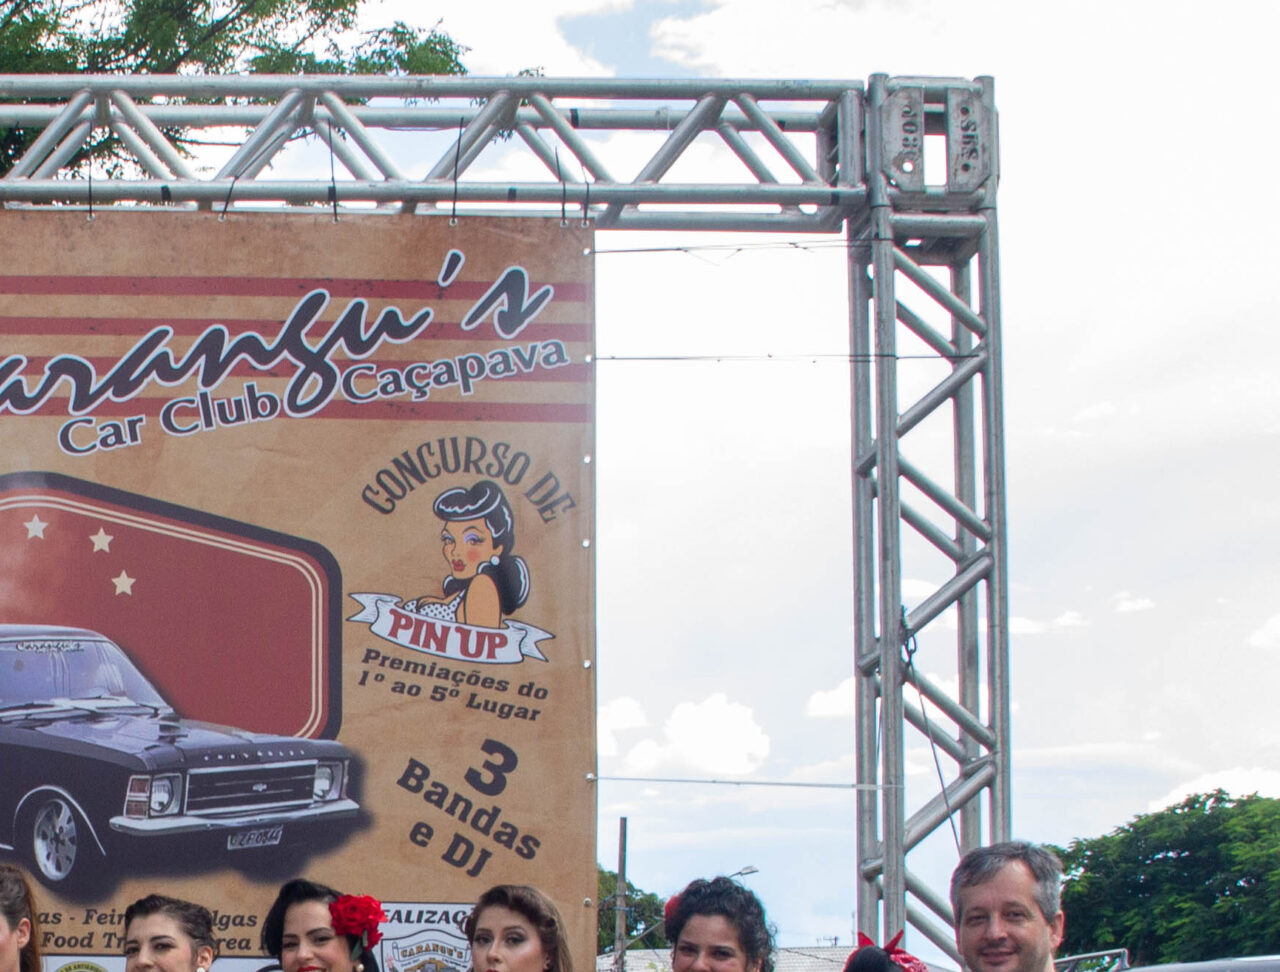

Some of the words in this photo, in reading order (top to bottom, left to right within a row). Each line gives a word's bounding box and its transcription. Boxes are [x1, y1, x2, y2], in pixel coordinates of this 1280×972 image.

[58, 413, 146, 456] Car
[159, 383, 282, 437] Club
[340, 337, 570, 403] Caçapava
[361, 436, 531, 515] CONCURSO
[524, 470, 577, 524] DE
[387, 608, 450, 653] PIN
[454, 625, 508, 660] UP
[361, 648, 510, 692] Premiações
[517, 681, 549, 700] do
[390, 680, 422, 697] ao
[466, 693, 541, 721] Lugar
[463, 738, 519, 797] 3
[396, 757, 542, 860] Bandas
[409, 820, 435, 848] e
[441, 832, 494, 878] DJ
[41, 931, 95, 949] Food
[82, 908, 127, 926] Feir
